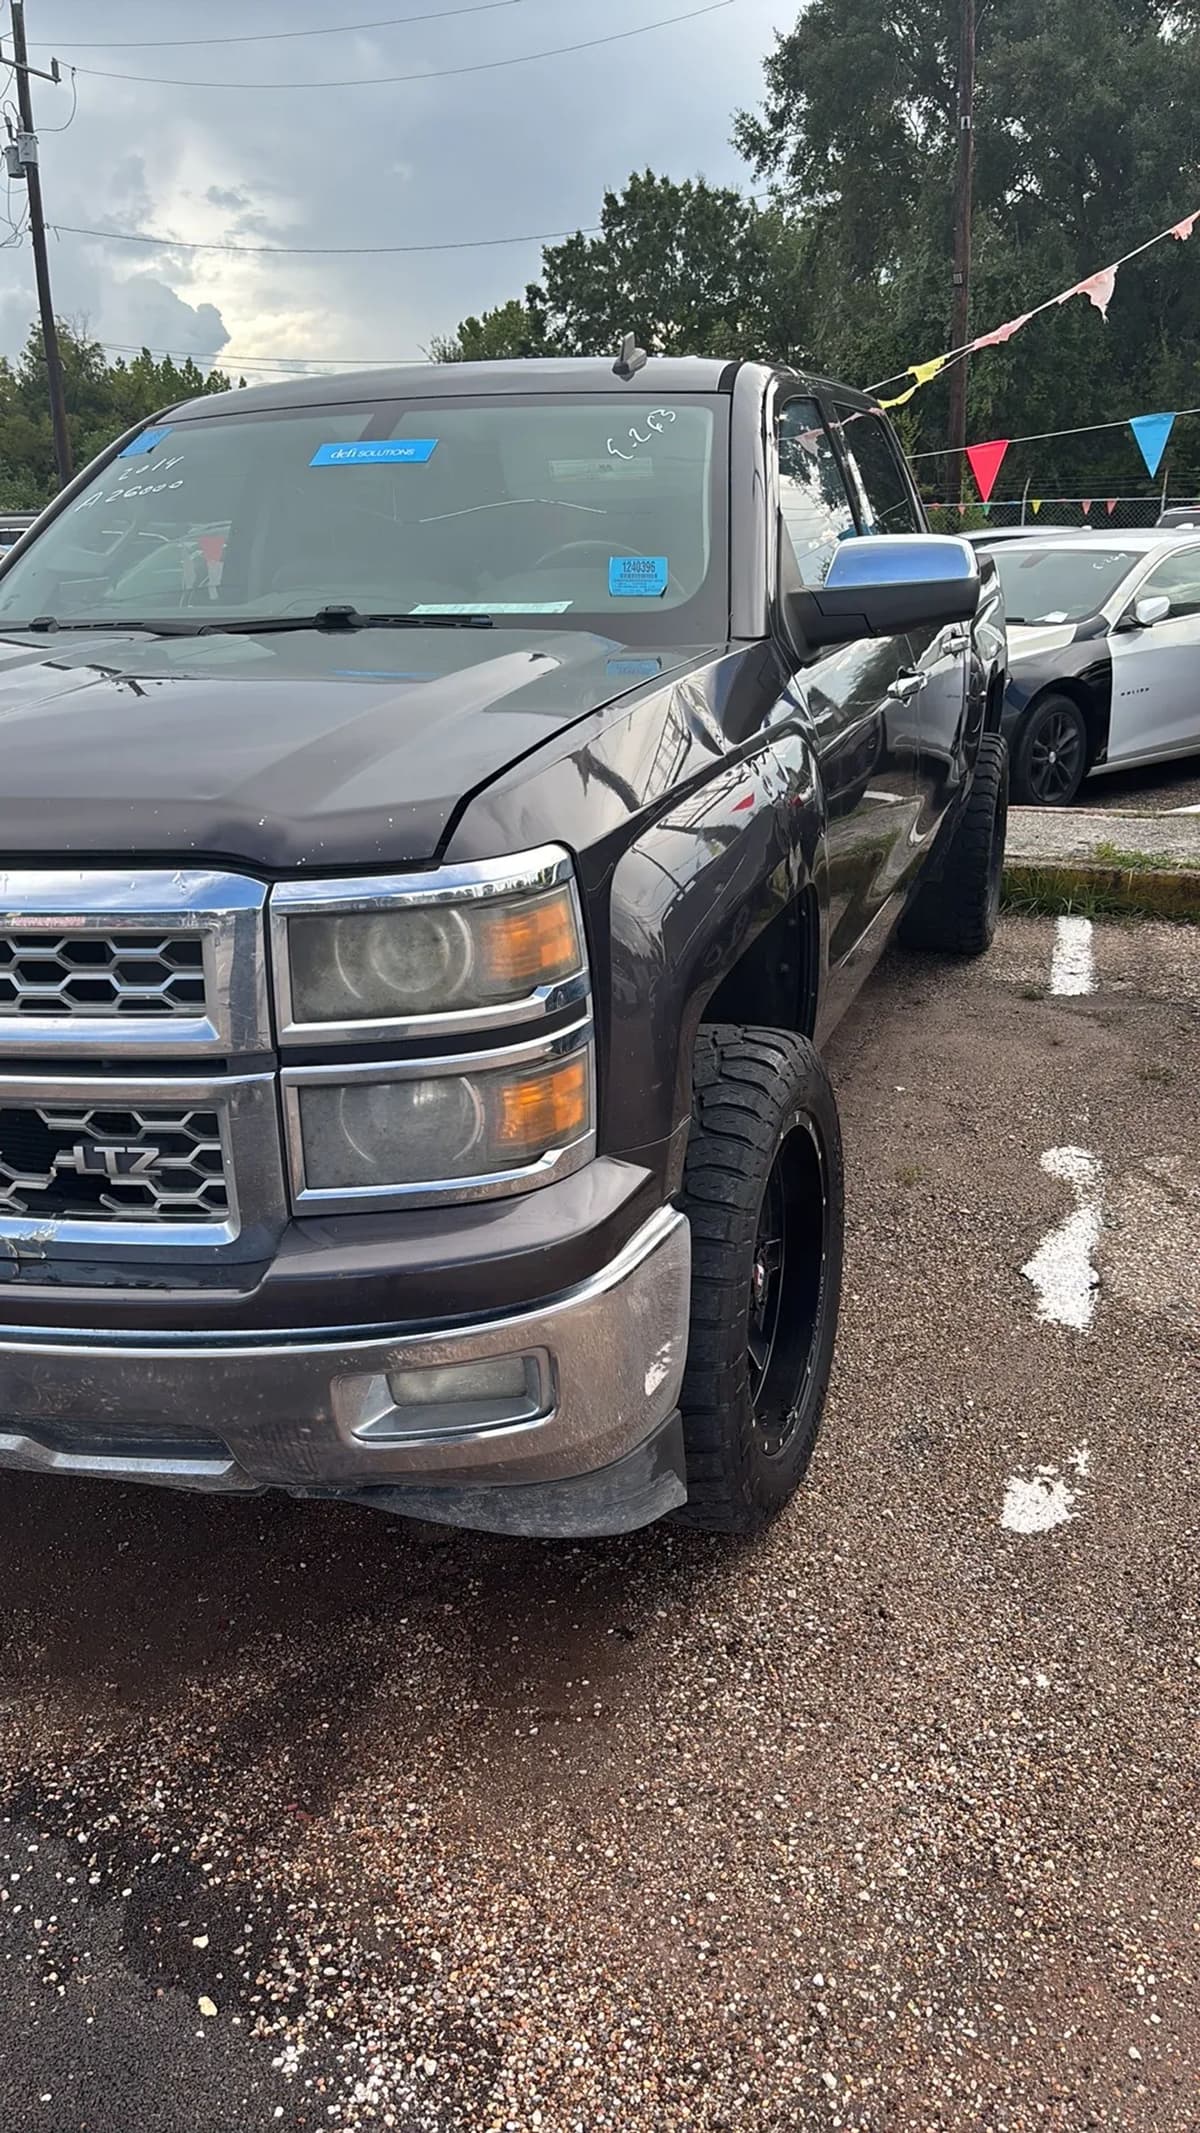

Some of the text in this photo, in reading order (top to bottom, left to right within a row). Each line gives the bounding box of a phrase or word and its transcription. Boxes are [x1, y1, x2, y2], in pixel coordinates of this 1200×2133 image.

[330, 447, 415, 459] defi SOLUTIONS
[622, 560, 656, 574] 1240396
[73, 1145, 162, 1176] LTZ
